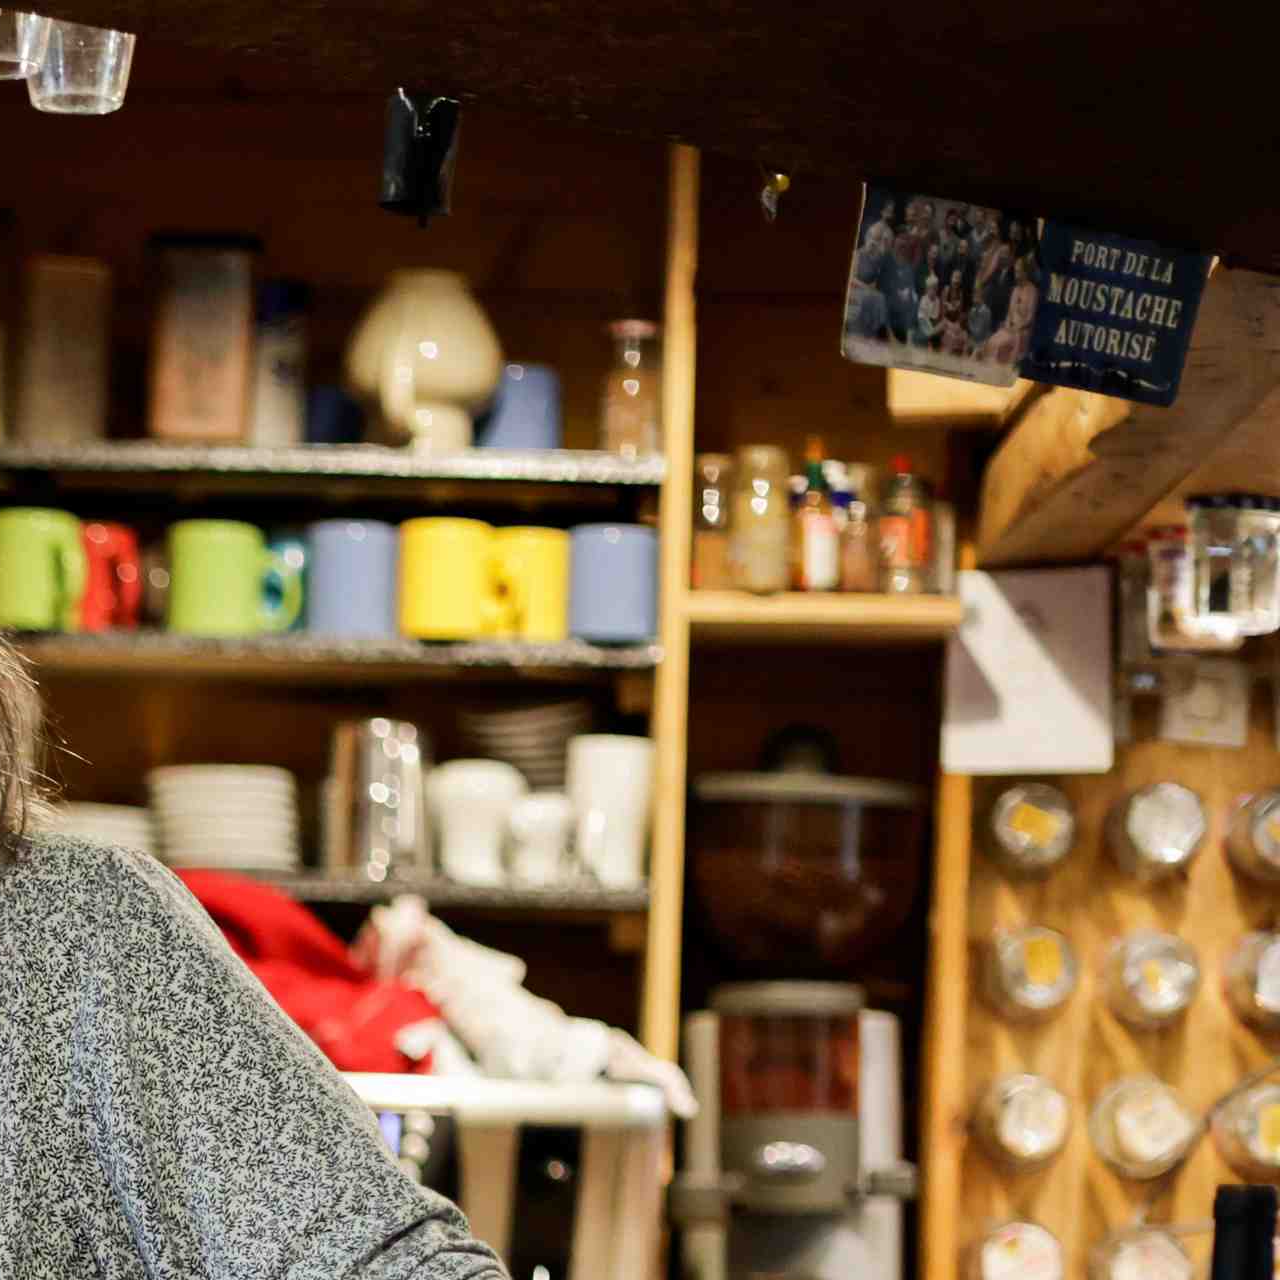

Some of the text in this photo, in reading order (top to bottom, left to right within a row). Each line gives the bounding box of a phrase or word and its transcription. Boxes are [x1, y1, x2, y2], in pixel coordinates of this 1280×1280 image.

[1071, 240, 1175, 284] PORT DE LA
[1048, 272, 1183, 328] MOUSTACHE
